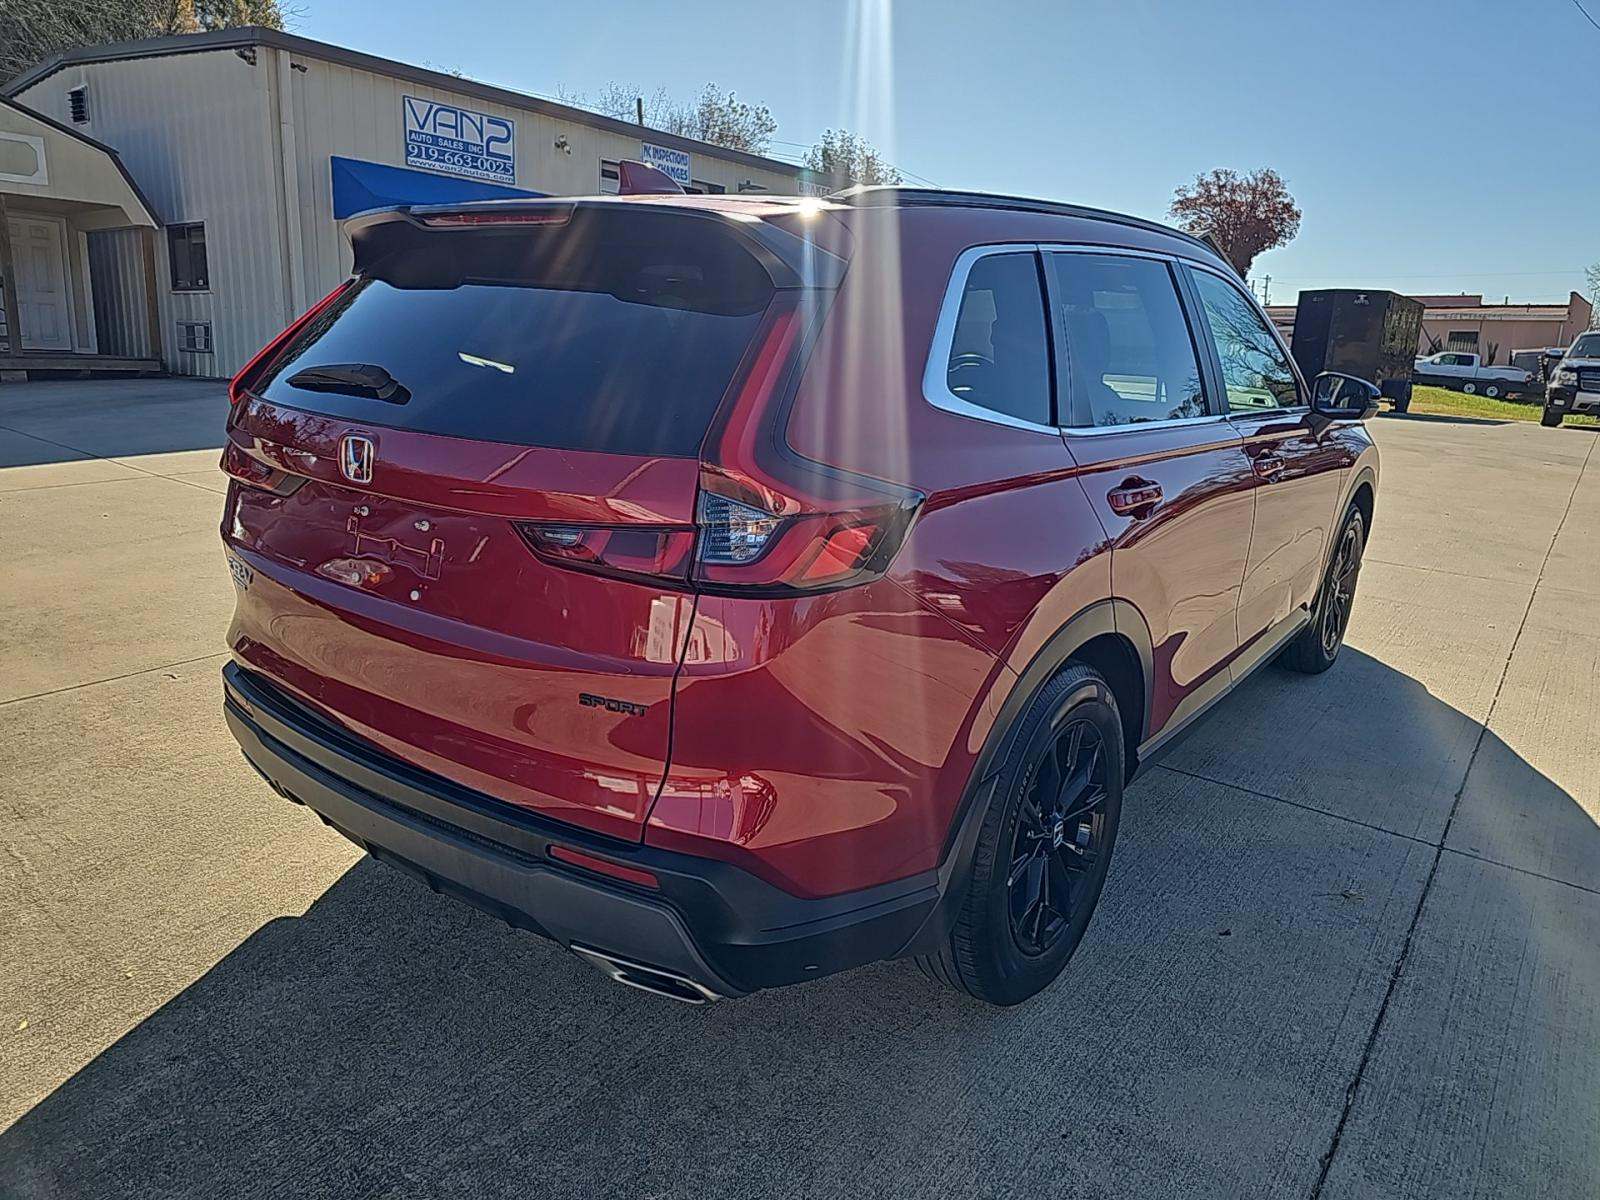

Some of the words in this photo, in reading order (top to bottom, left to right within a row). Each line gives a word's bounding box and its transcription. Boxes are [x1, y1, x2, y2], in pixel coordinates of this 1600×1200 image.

[407, 99, 511, 161] VAN2
[410, 132, 432, 144] AUTO
[438, 138, 464, 151] SALES
[468, 145, 483, 154] INC
[408, 144, 513, 175] 919-663-0025
[652, 146, 688, 166] INSPECTIONS
[408, 158, 514, 182] www.van2autos.com
[578, 693, 650, 717] SPORT
